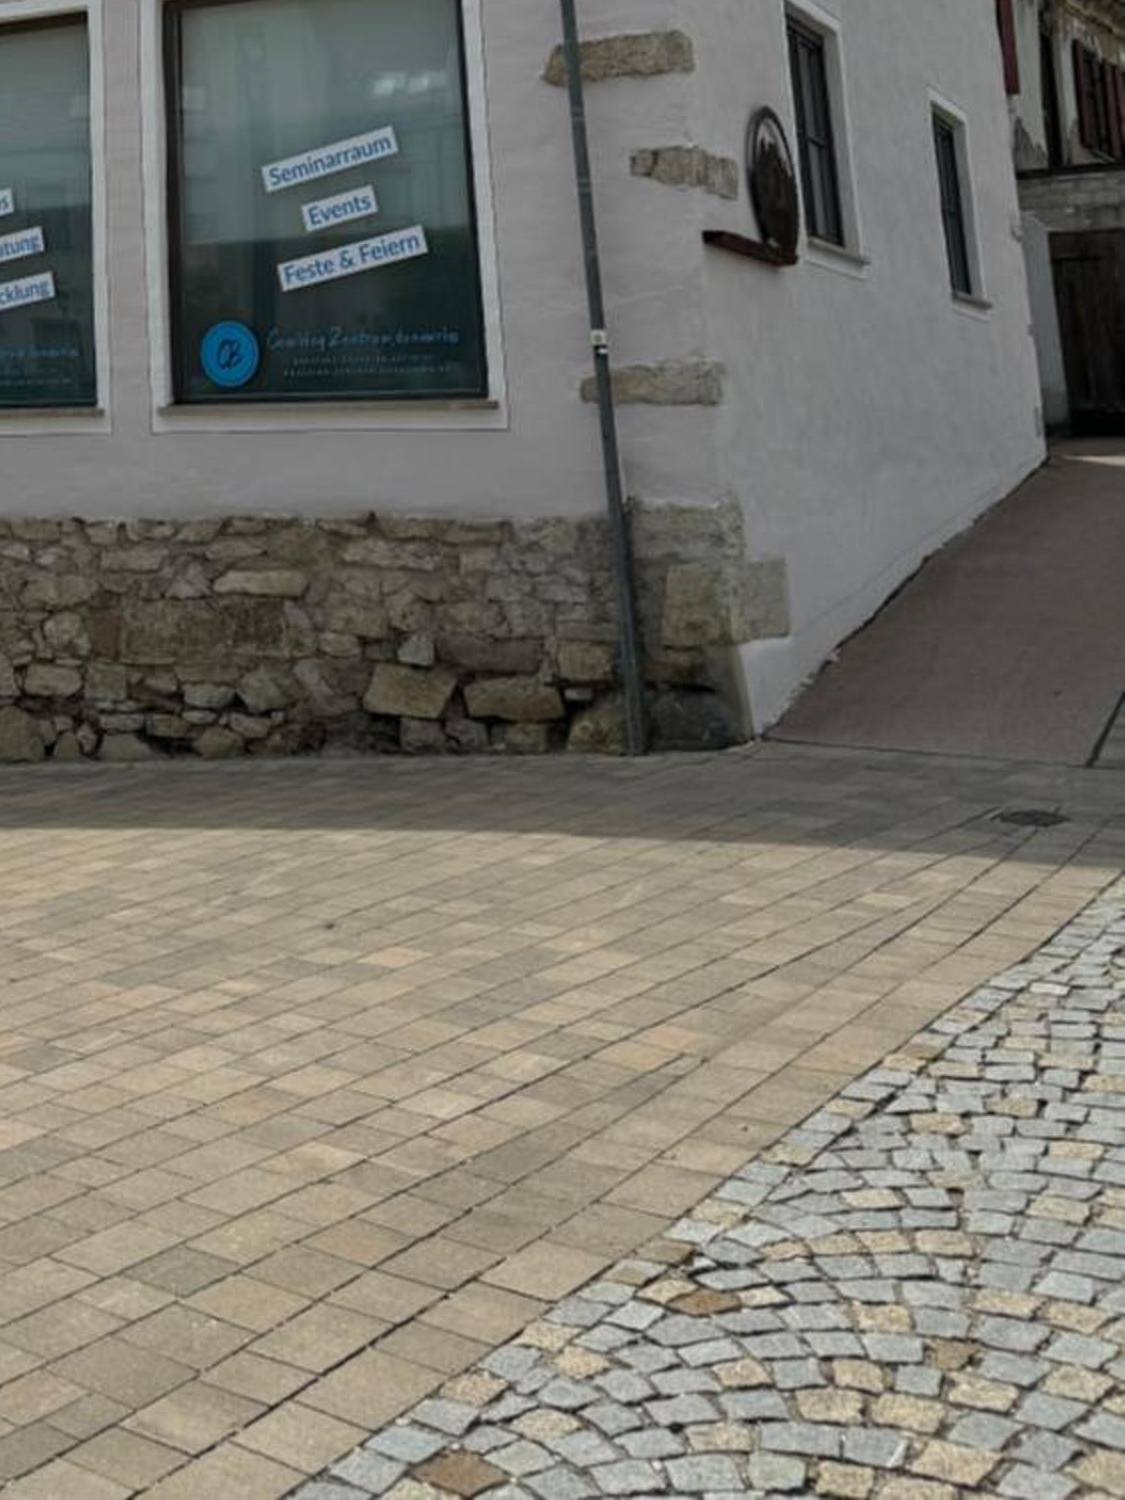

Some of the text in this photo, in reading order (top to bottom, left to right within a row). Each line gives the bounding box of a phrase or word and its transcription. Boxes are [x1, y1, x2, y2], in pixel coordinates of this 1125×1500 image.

[267, 135, 393, 187] Seminarraum
[307, 194, 373, 227] Events
[283, 233, 421, 285] Feste & Feiern
